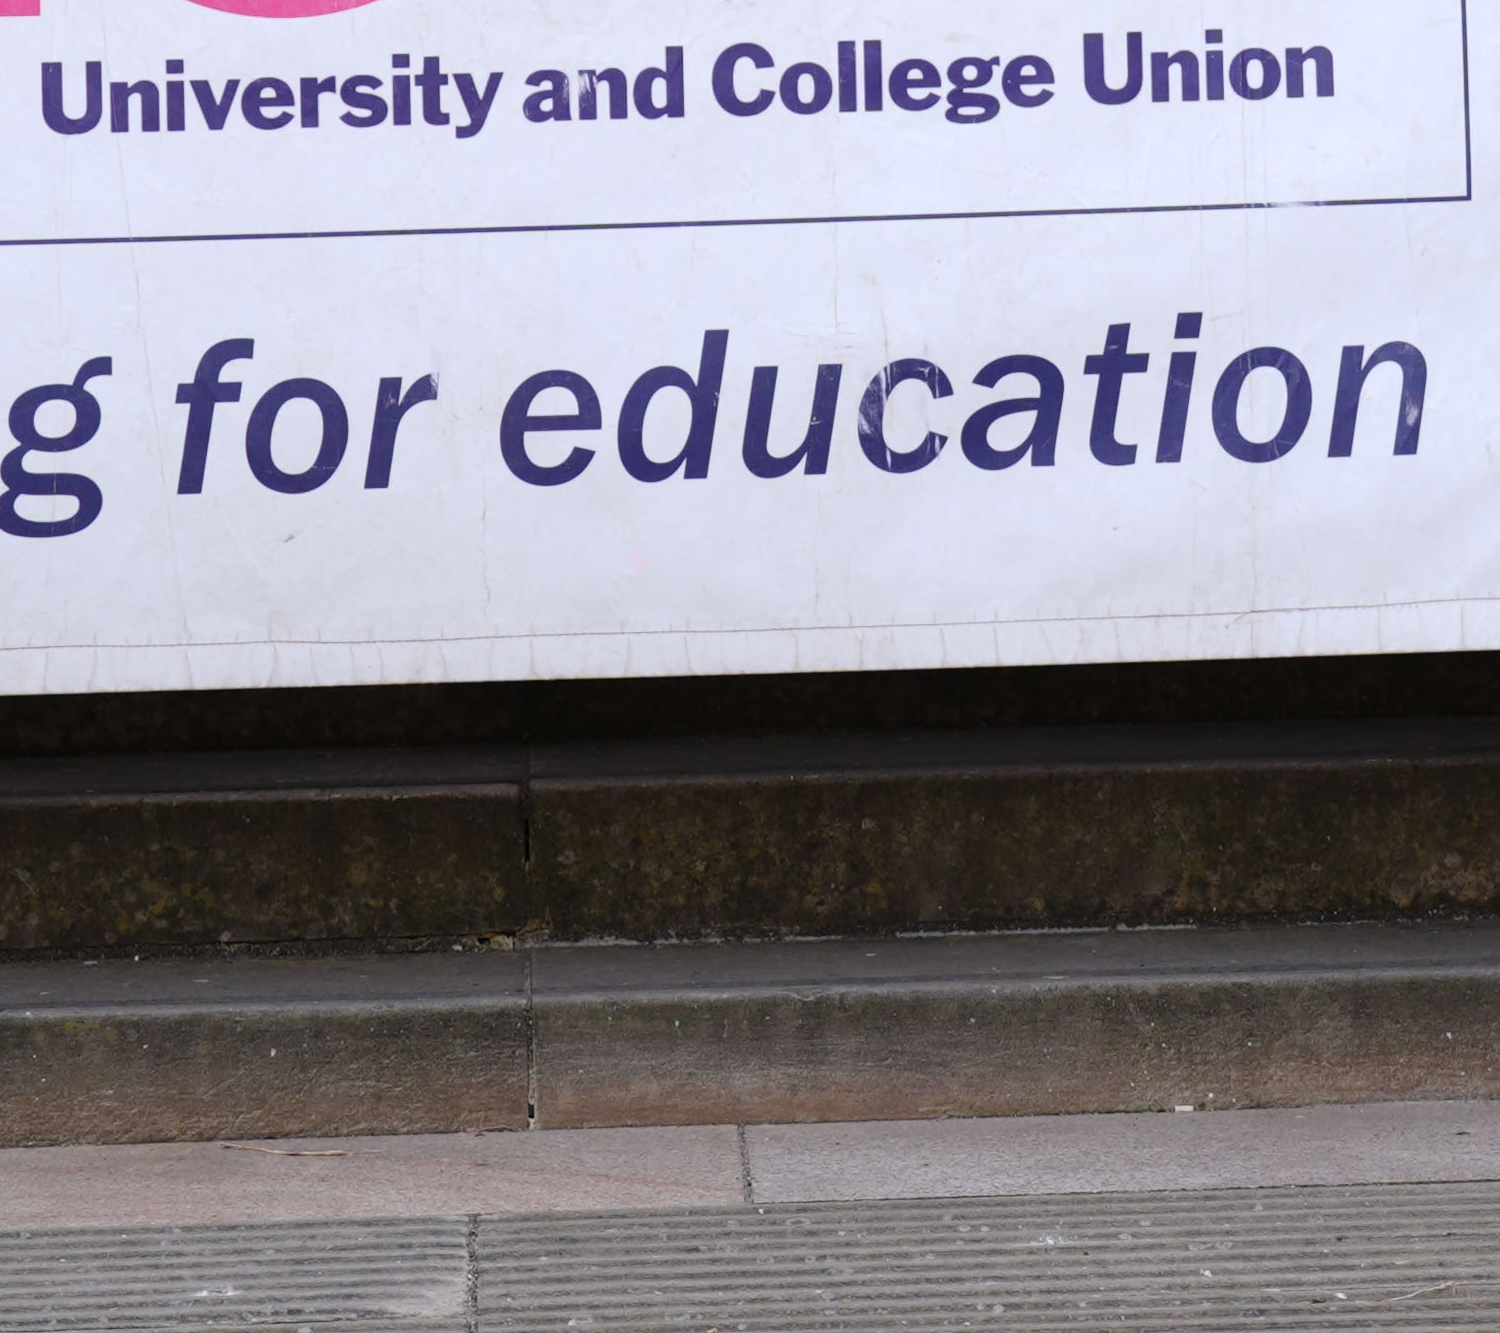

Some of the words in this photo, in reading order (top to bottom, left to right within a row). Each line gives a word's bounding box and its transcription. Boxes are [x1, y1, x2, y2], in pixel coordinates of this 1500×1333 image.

[41, 53, 501, 141] University
[522, 42, 684, 123] and
[709, 35, 1054, 126] College
[1081, 29, 1337, 109] Union
[172, 335, 440, 497] for
[497, 311, 1432, 485] education
